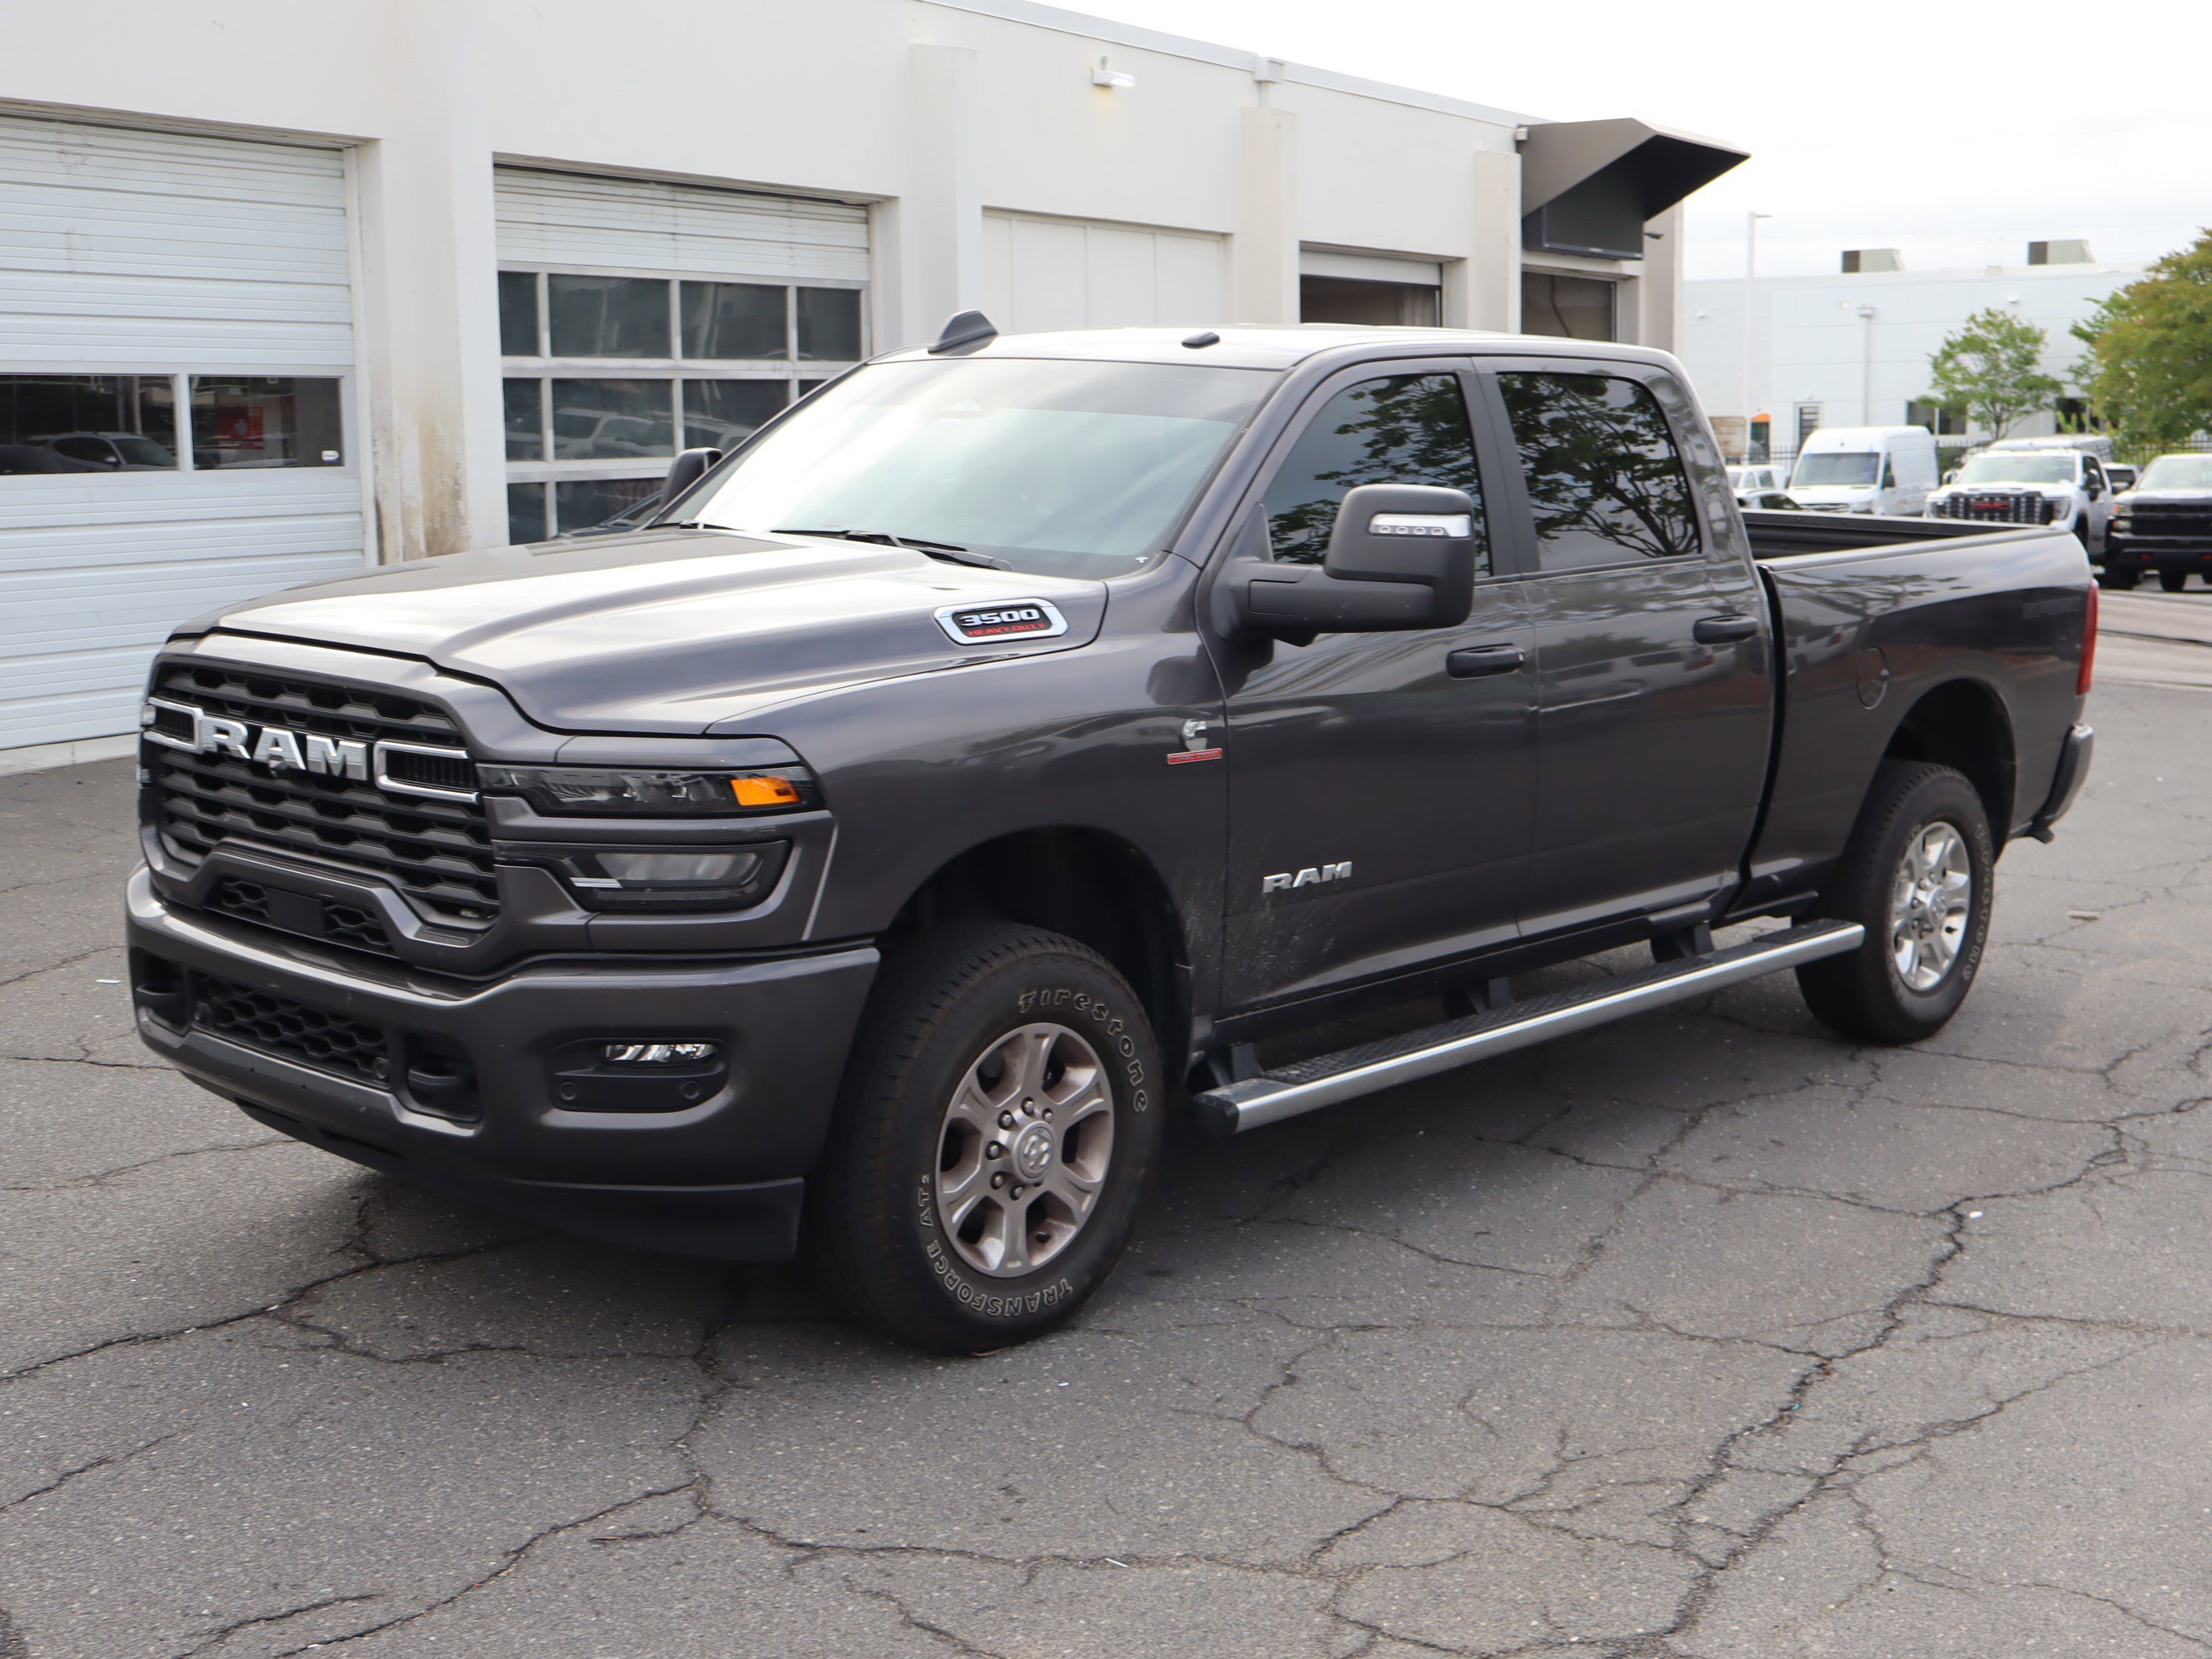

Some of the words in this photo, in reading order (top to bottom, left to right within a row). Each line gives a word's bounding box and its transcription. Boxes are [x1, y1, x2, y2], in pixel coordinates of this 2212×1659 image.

[959, 609, 1040, 626] 3500
[968, 625, 1010, 636] HEAVY
[1012, 623, 1046, 631] DUTY
[200, 715, 367, 781] RAM
[1263, 861, 1353, 894] RAM
[1018, 989, 1148, 1113] Firestone
[926, 1239, 1073, 1317] TRANSFORCE
